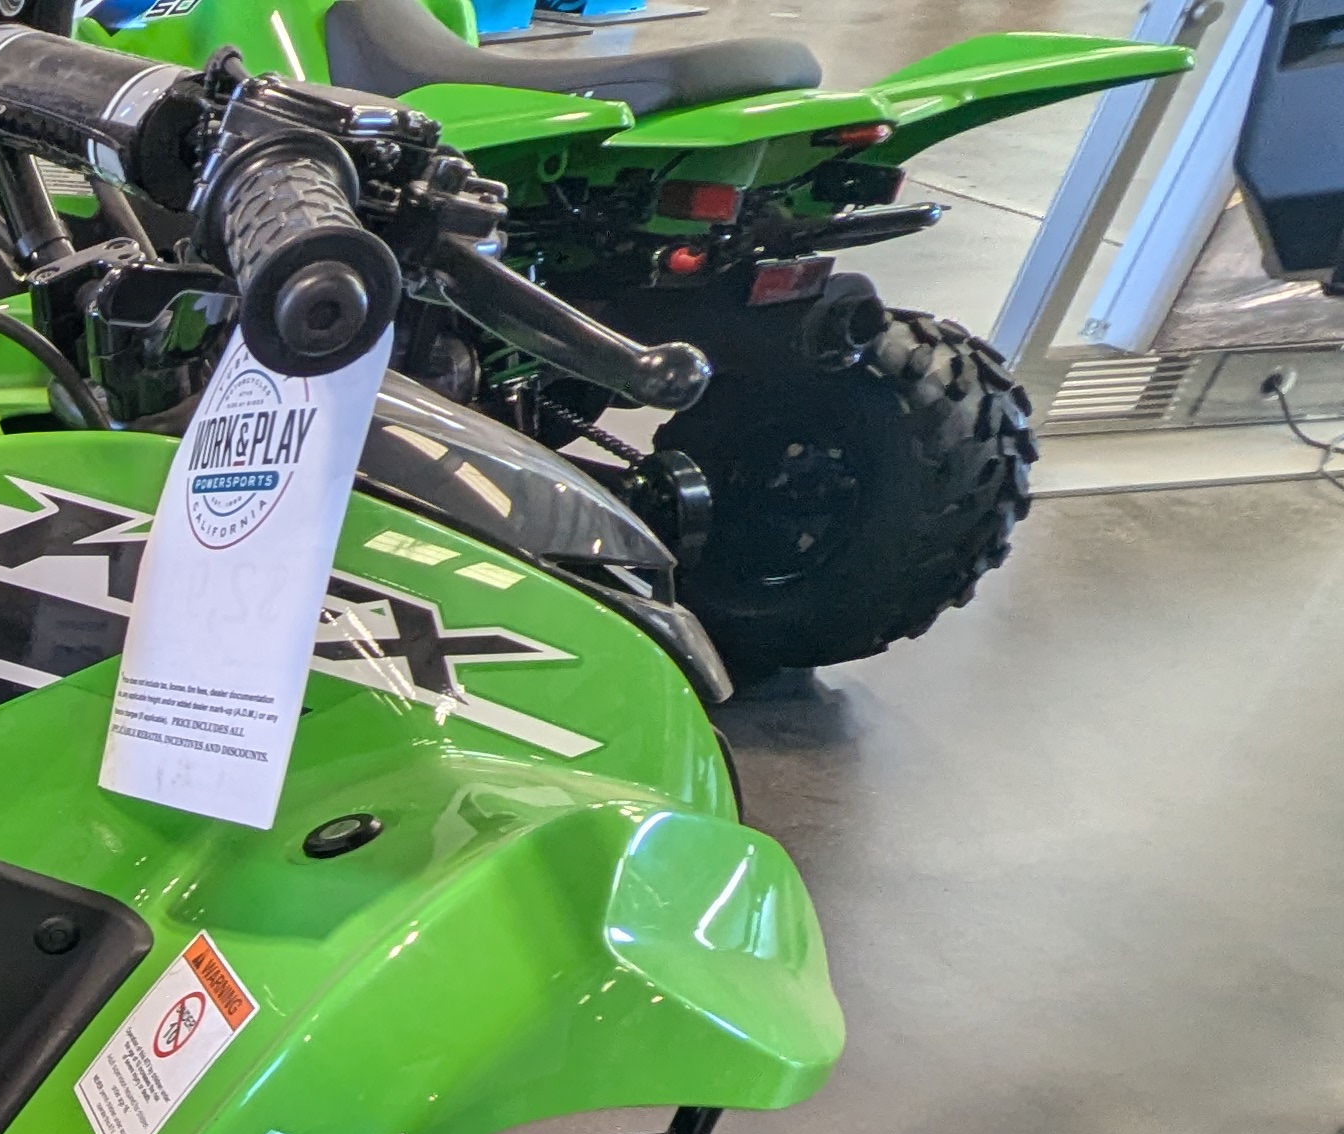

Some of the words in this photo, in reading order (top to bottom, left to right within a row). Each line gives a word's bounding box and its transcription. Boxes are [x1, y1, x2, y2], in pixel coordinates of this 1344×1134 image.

[194, 475, 274, 490] POWERSPORTS
[192, 499, 268, 539] CALIFORNIA
[229, 689, 275, 704] documentation
[192, 720, 229, 735] INCLUDES
[229, 726, 245, 737] ALL
[203, 743, 221, 754] AND
[202, 960, 241, 1014] WARNING
